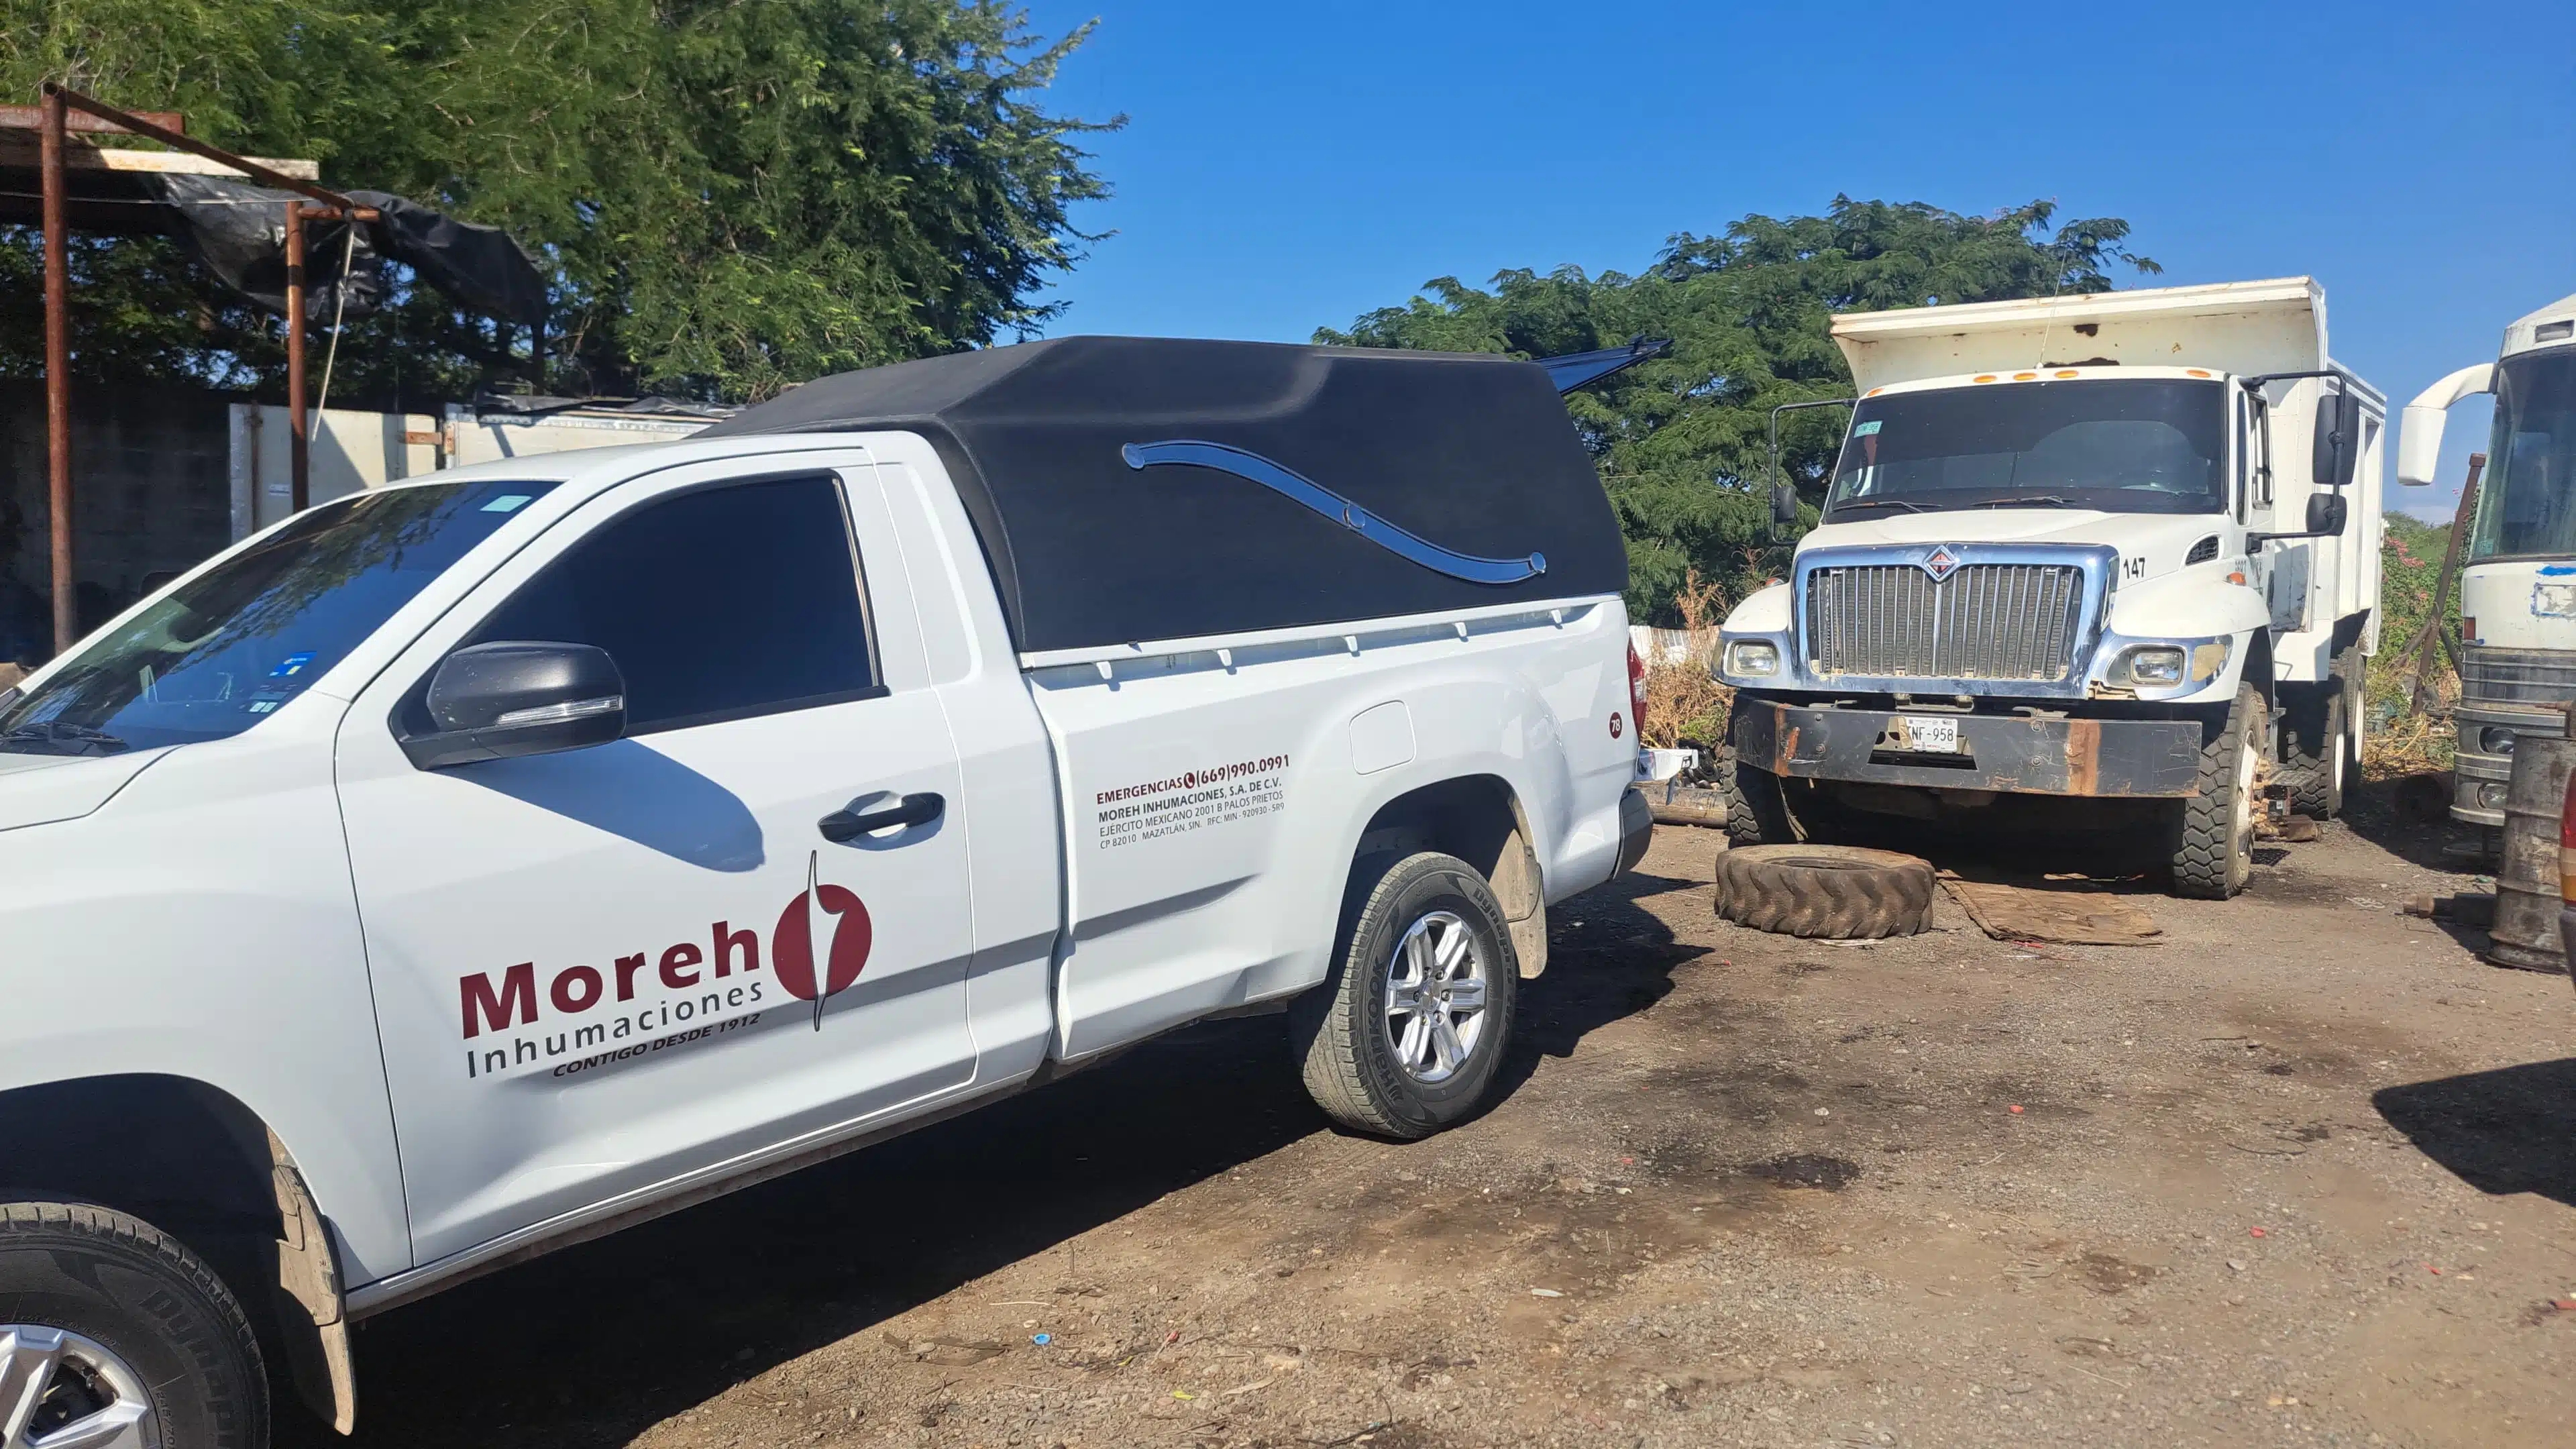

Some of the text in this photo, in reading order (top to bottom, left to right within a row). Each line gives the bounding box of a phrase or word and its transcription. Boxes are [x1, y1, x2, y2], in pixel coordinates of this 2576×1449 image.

[2123, 557, 2146, 579] 147
[1611, 718, 1621, 733] 78
[1097, 753, 1289, 804] EMERGENCIAS (669)990.0991
[1098, 777, 1282, 823] MOREH INHUMACIONES, S.A. DE C.V.
[1099, 790, 1283, 837] EJÉRCITO MEXICANO 2001 B PALOS PRIETOS
[1099, 839, 1110, 849] CP
[1112, 834, 1136, 847] 82010
[1142, 822, 1187, 840] MAZATLÁN,
[1224, 812, 1238, 822] MIN
[460, 920, 760, 1040] Moreh
[467, 981, 763, 1078] Inhumaciones
[553, 1013, 761, 1077] CONTIGO DESDE 1912
